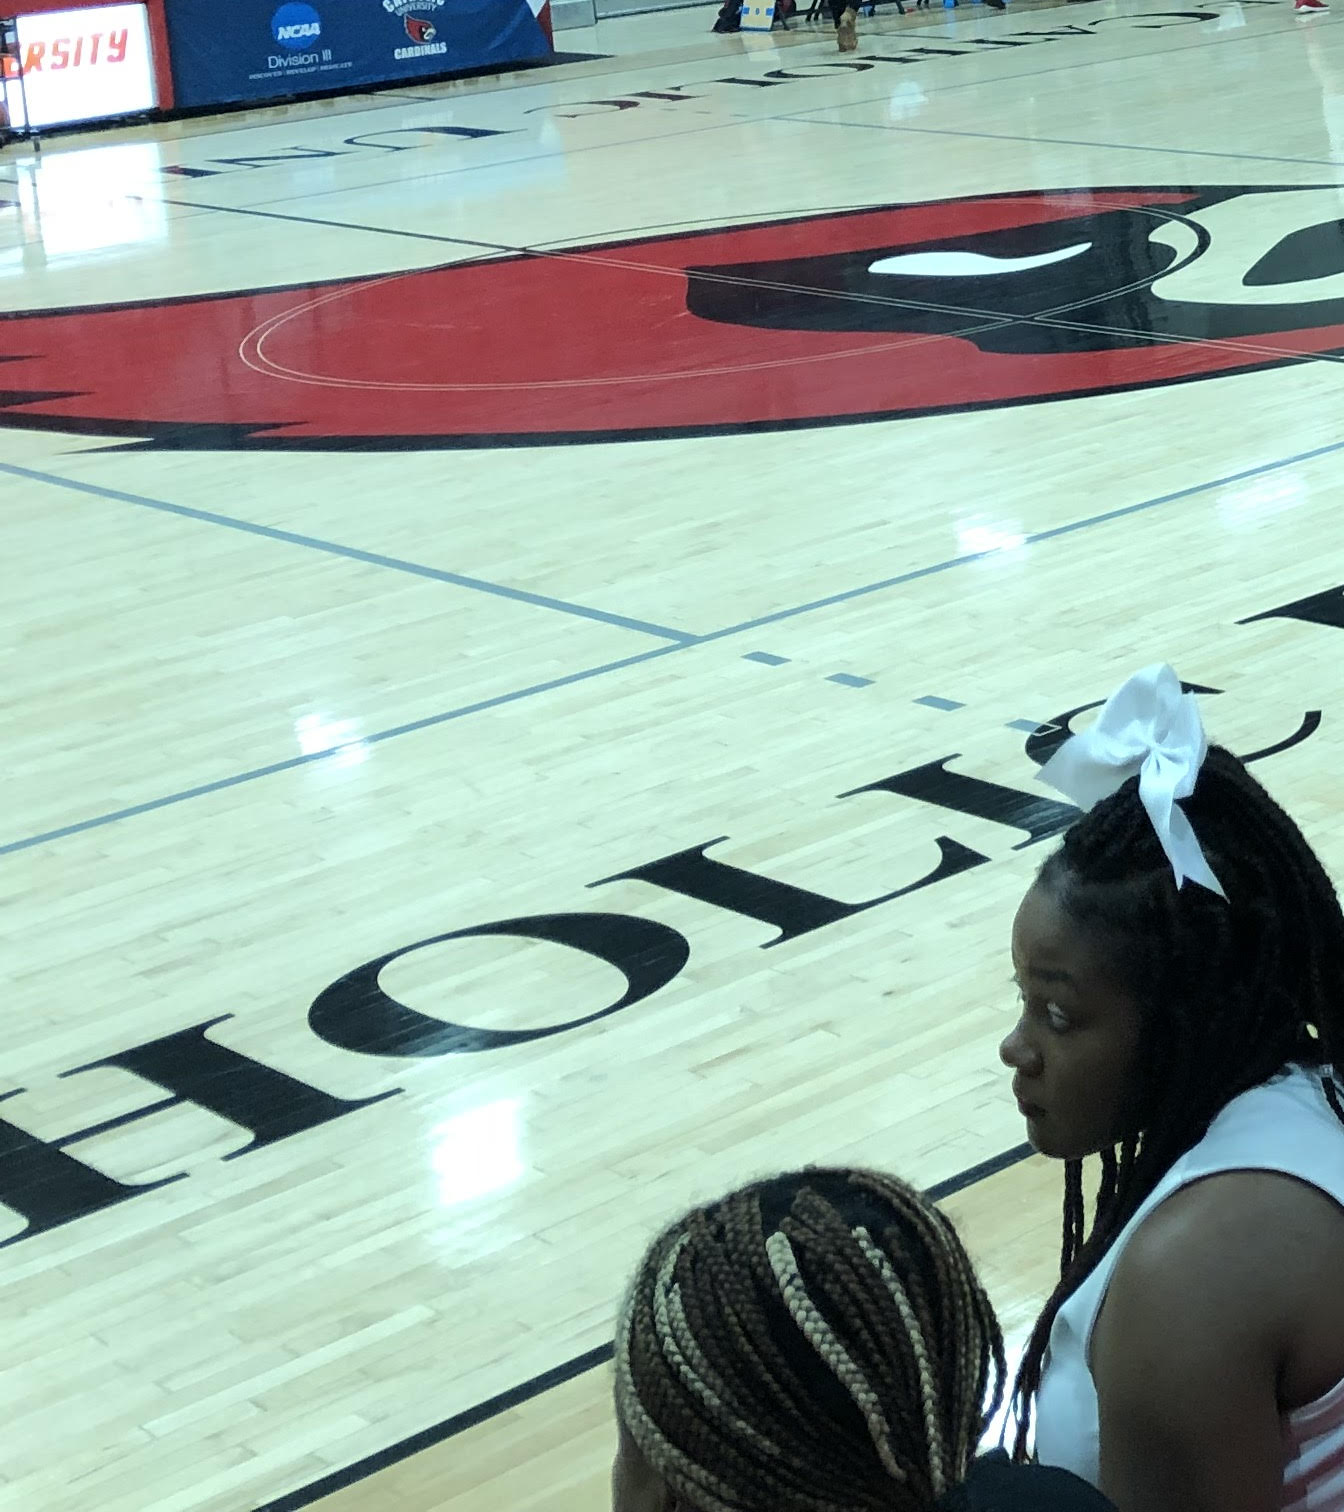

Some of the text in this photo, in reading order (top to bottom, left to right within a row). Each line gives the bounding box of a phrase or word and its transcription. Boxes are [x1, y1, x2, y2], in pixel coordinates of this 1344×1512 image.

[394, 1, 437, 17] UNIVERSITY
[277, 22, 320, 40] NCAA
[268, 51, 319, 69] Division
[394, 42, 447, 60] CARDINALS
